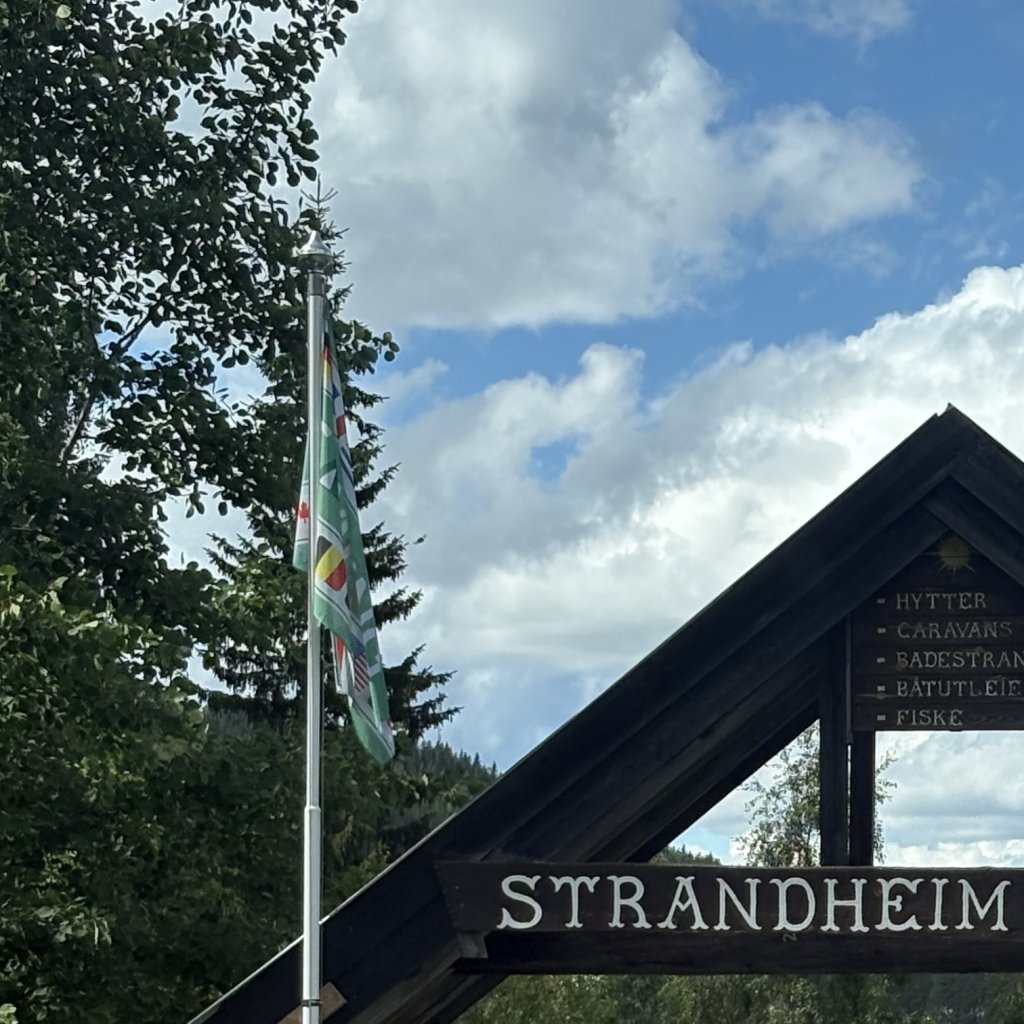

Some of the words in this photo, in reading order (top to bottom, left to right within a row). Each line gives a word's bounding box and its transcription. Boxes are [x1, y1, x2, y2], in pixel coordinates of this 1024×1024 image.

[896, 592, 987, 610] HYTTER
[897, 621, 1013, 639] CARAVANS
[896, 709, 964, 727] FISKE
[497, 875, 1010, 932] STRANDHEIM
